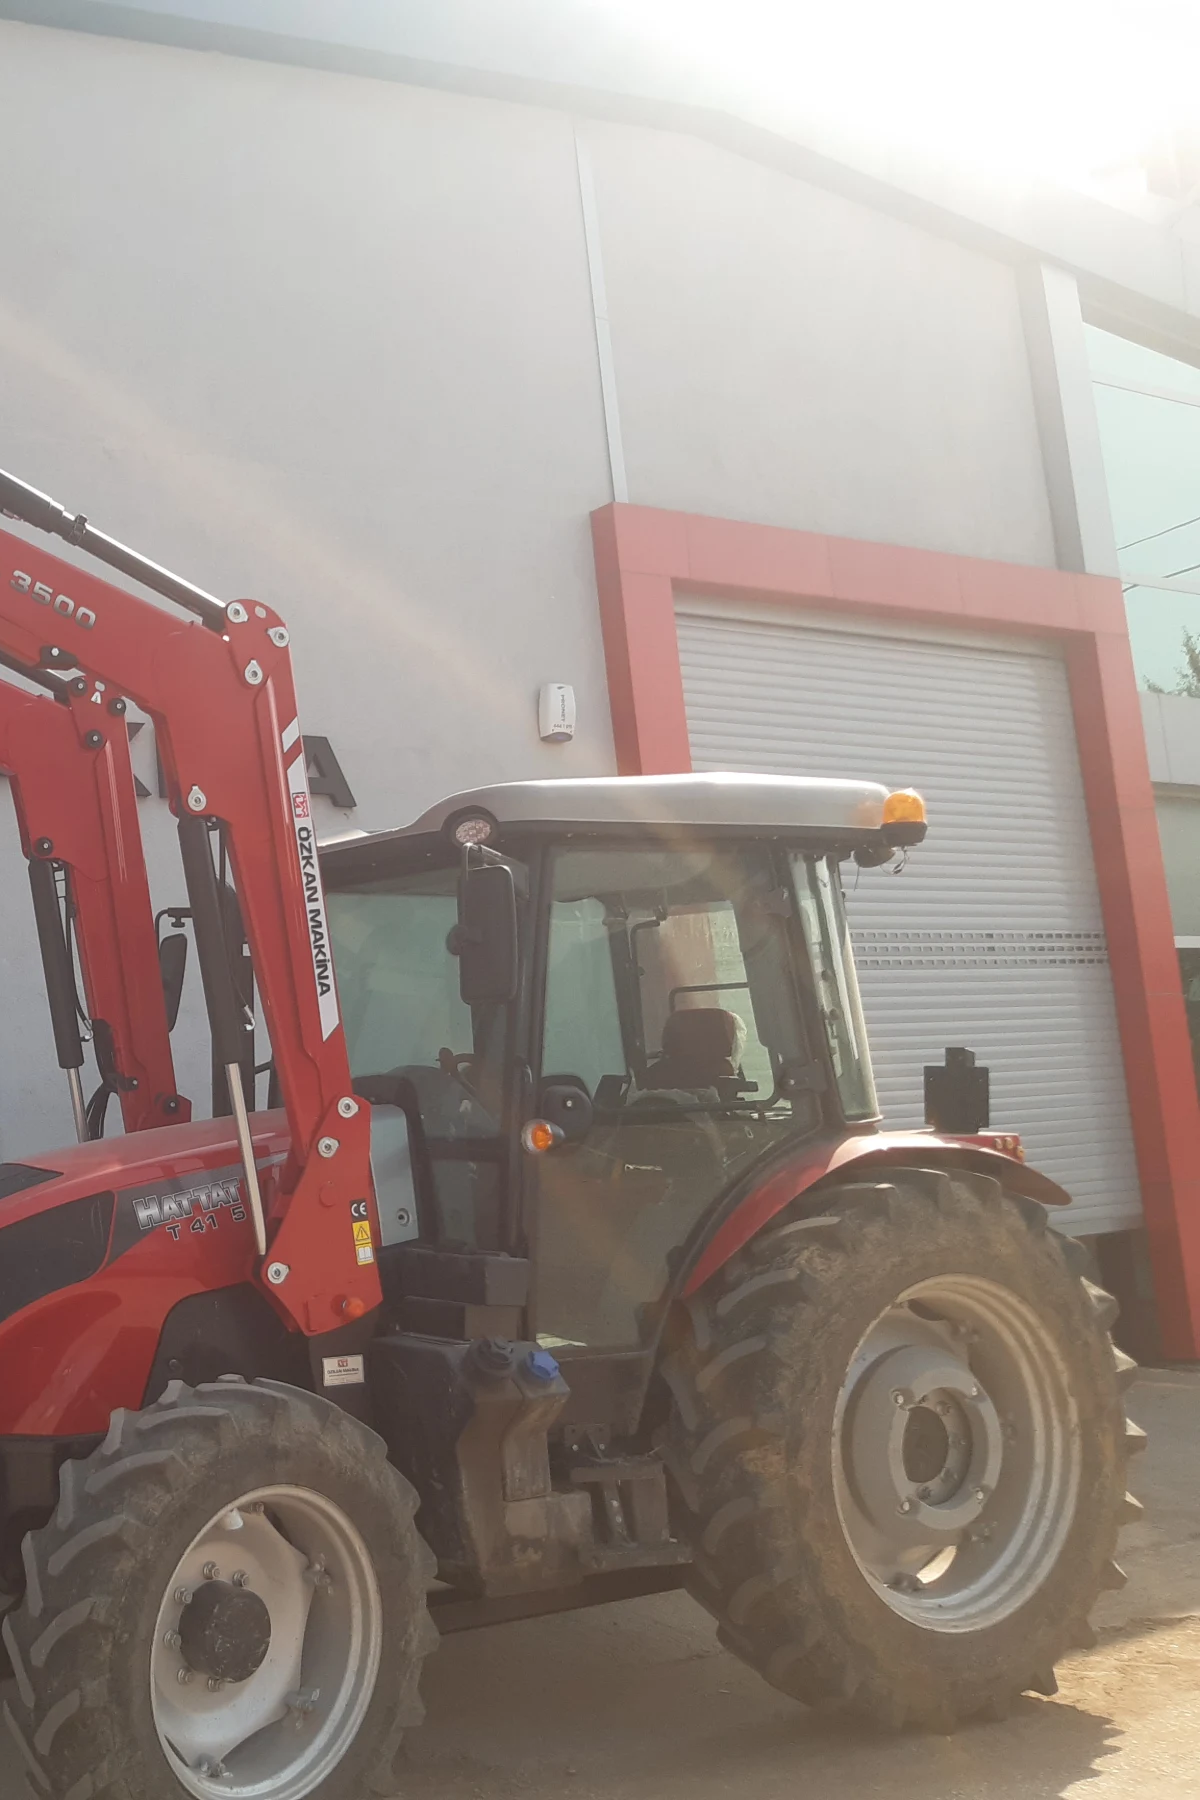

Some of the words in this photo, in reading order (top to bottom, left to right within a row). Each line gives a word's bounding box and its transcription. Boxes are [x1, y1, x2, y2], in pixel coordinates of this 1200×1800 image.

[10, 570, 96, 631] 3500
[297, 826, 319, 903] ÖZKAN
[308, 908, 331, 997] MAKİNA
[133, 1177, 240, 1230] HATTAT
[351, 1202, 367, 1217] CE
[166, 1223, 181, 1240] T
